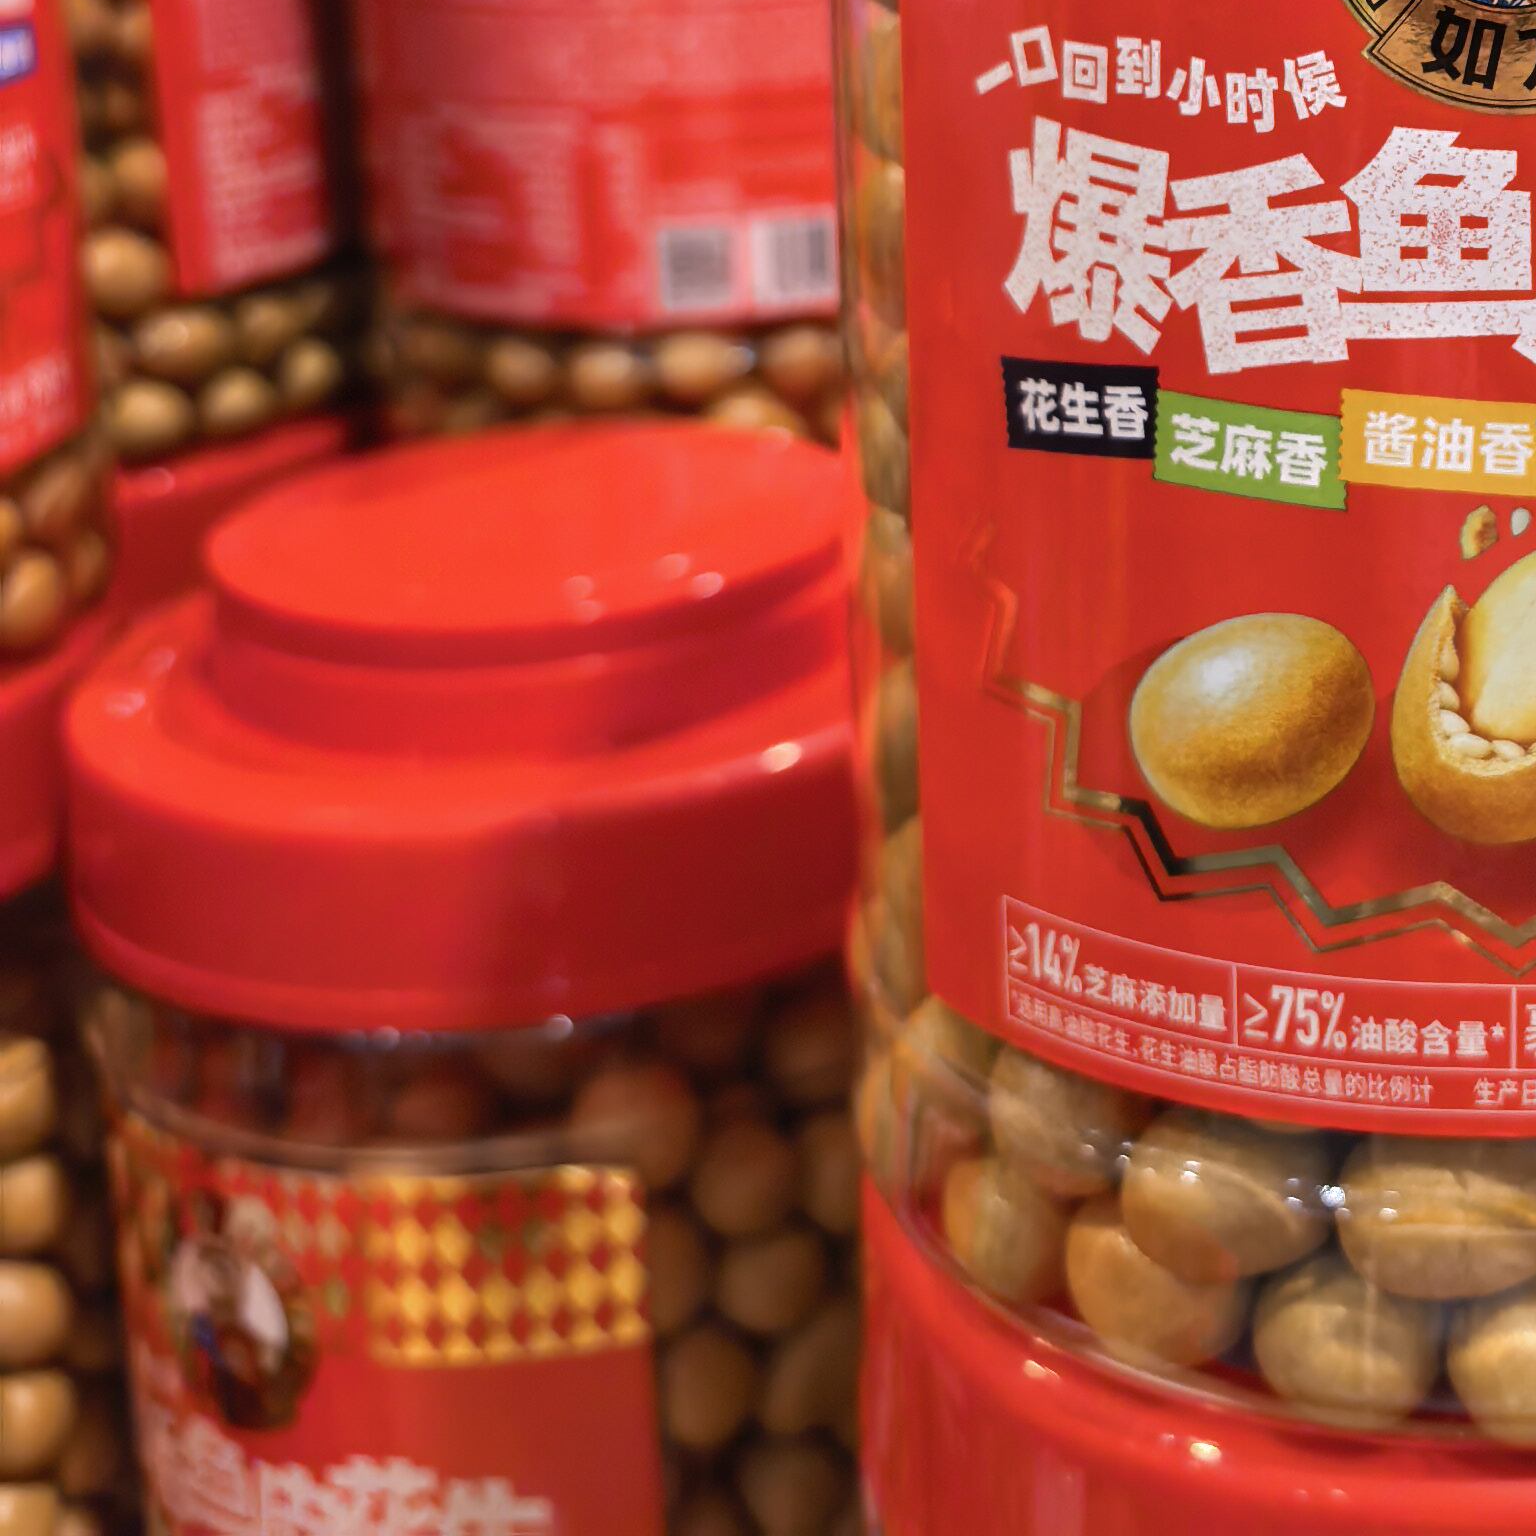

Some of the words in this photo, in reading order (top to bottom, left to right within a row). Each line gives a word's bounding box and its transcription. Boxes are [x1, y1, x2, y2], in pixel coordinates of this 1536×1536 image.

[974, 24, 1348, 133] 一口回到小时候
[1018, 377, 1149, 440] 花生香
[1170, 411, 1329, 488] 芝麻香
[1364, 409, 1536, 478] 酱油香
